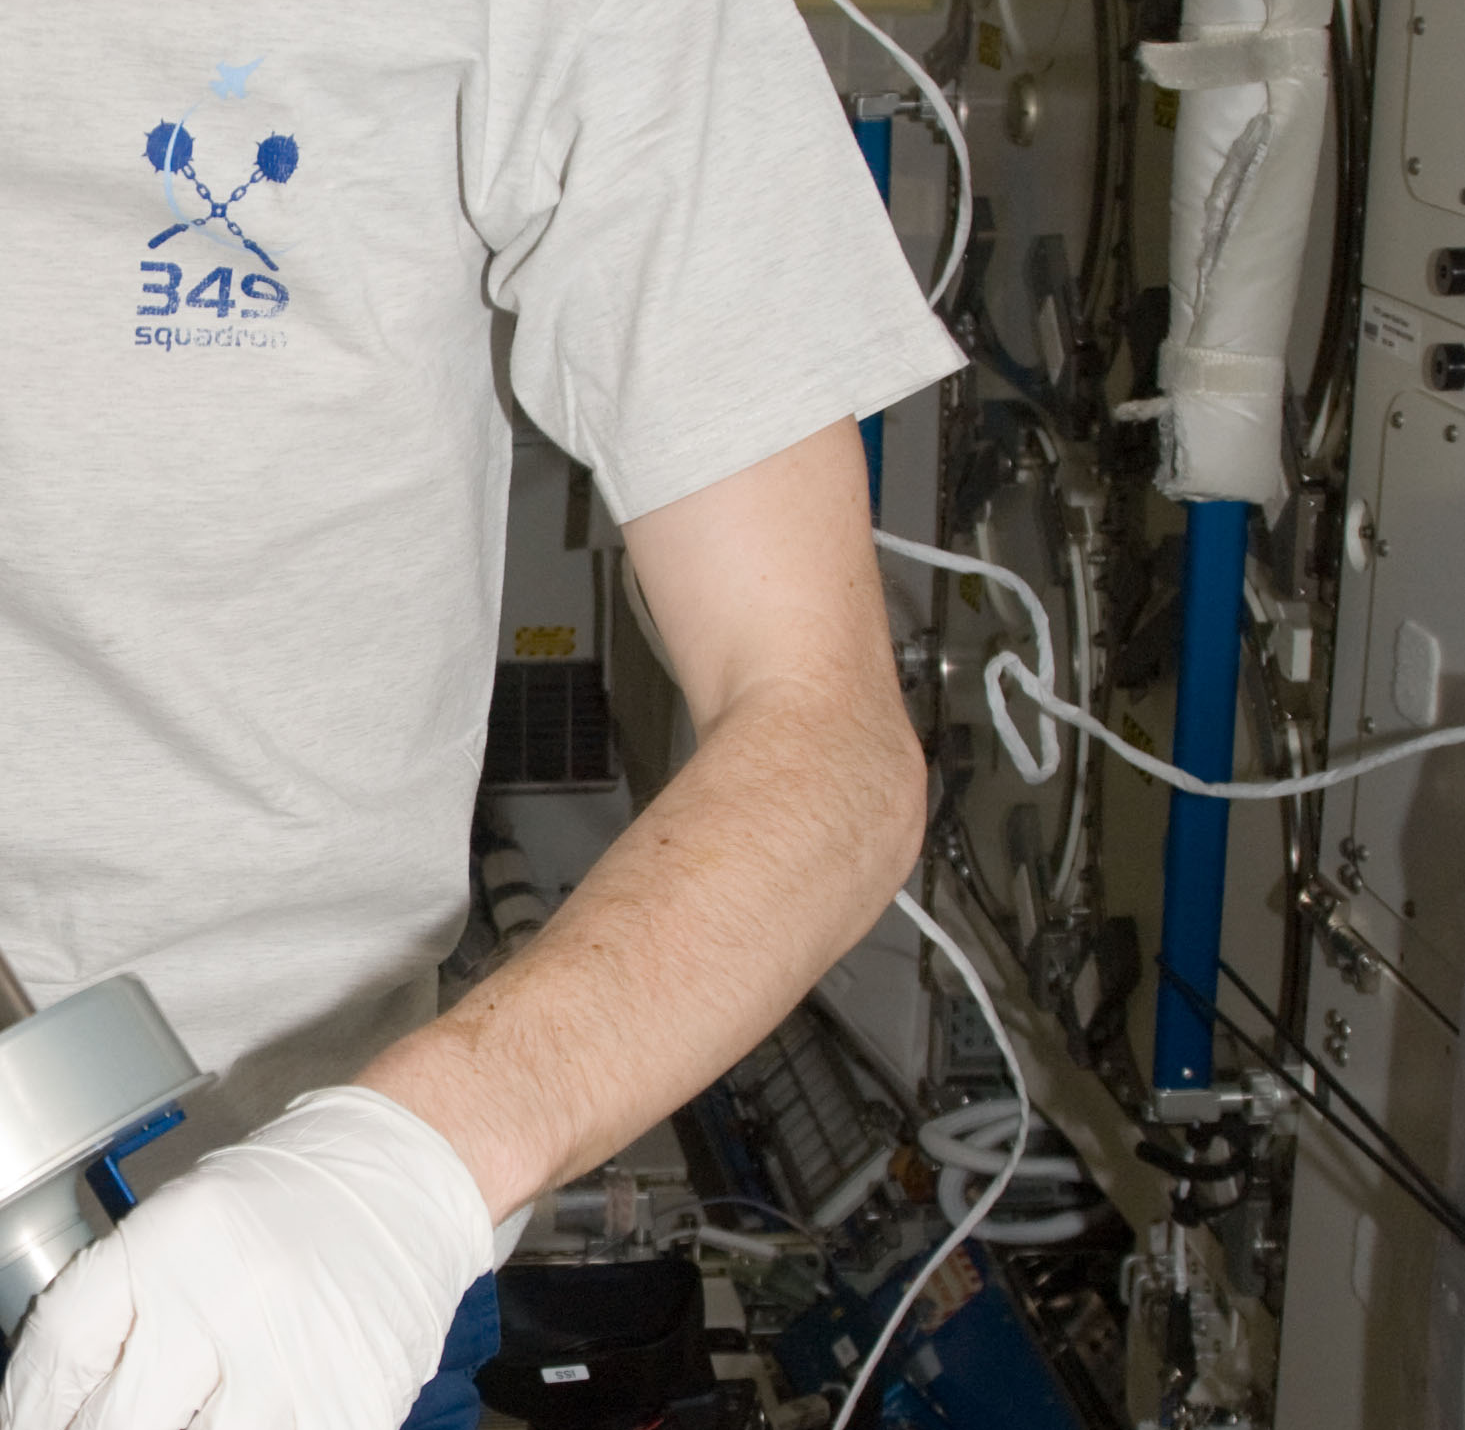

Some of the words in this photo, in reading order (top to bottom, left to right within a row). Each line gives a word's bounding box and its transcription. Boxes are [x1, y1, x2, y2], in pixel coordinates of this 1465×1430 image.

[136, 261, 291, 319] 349
[134, 324, 289, 352] squadron
[554, 1370, 577, 1381] ISS
